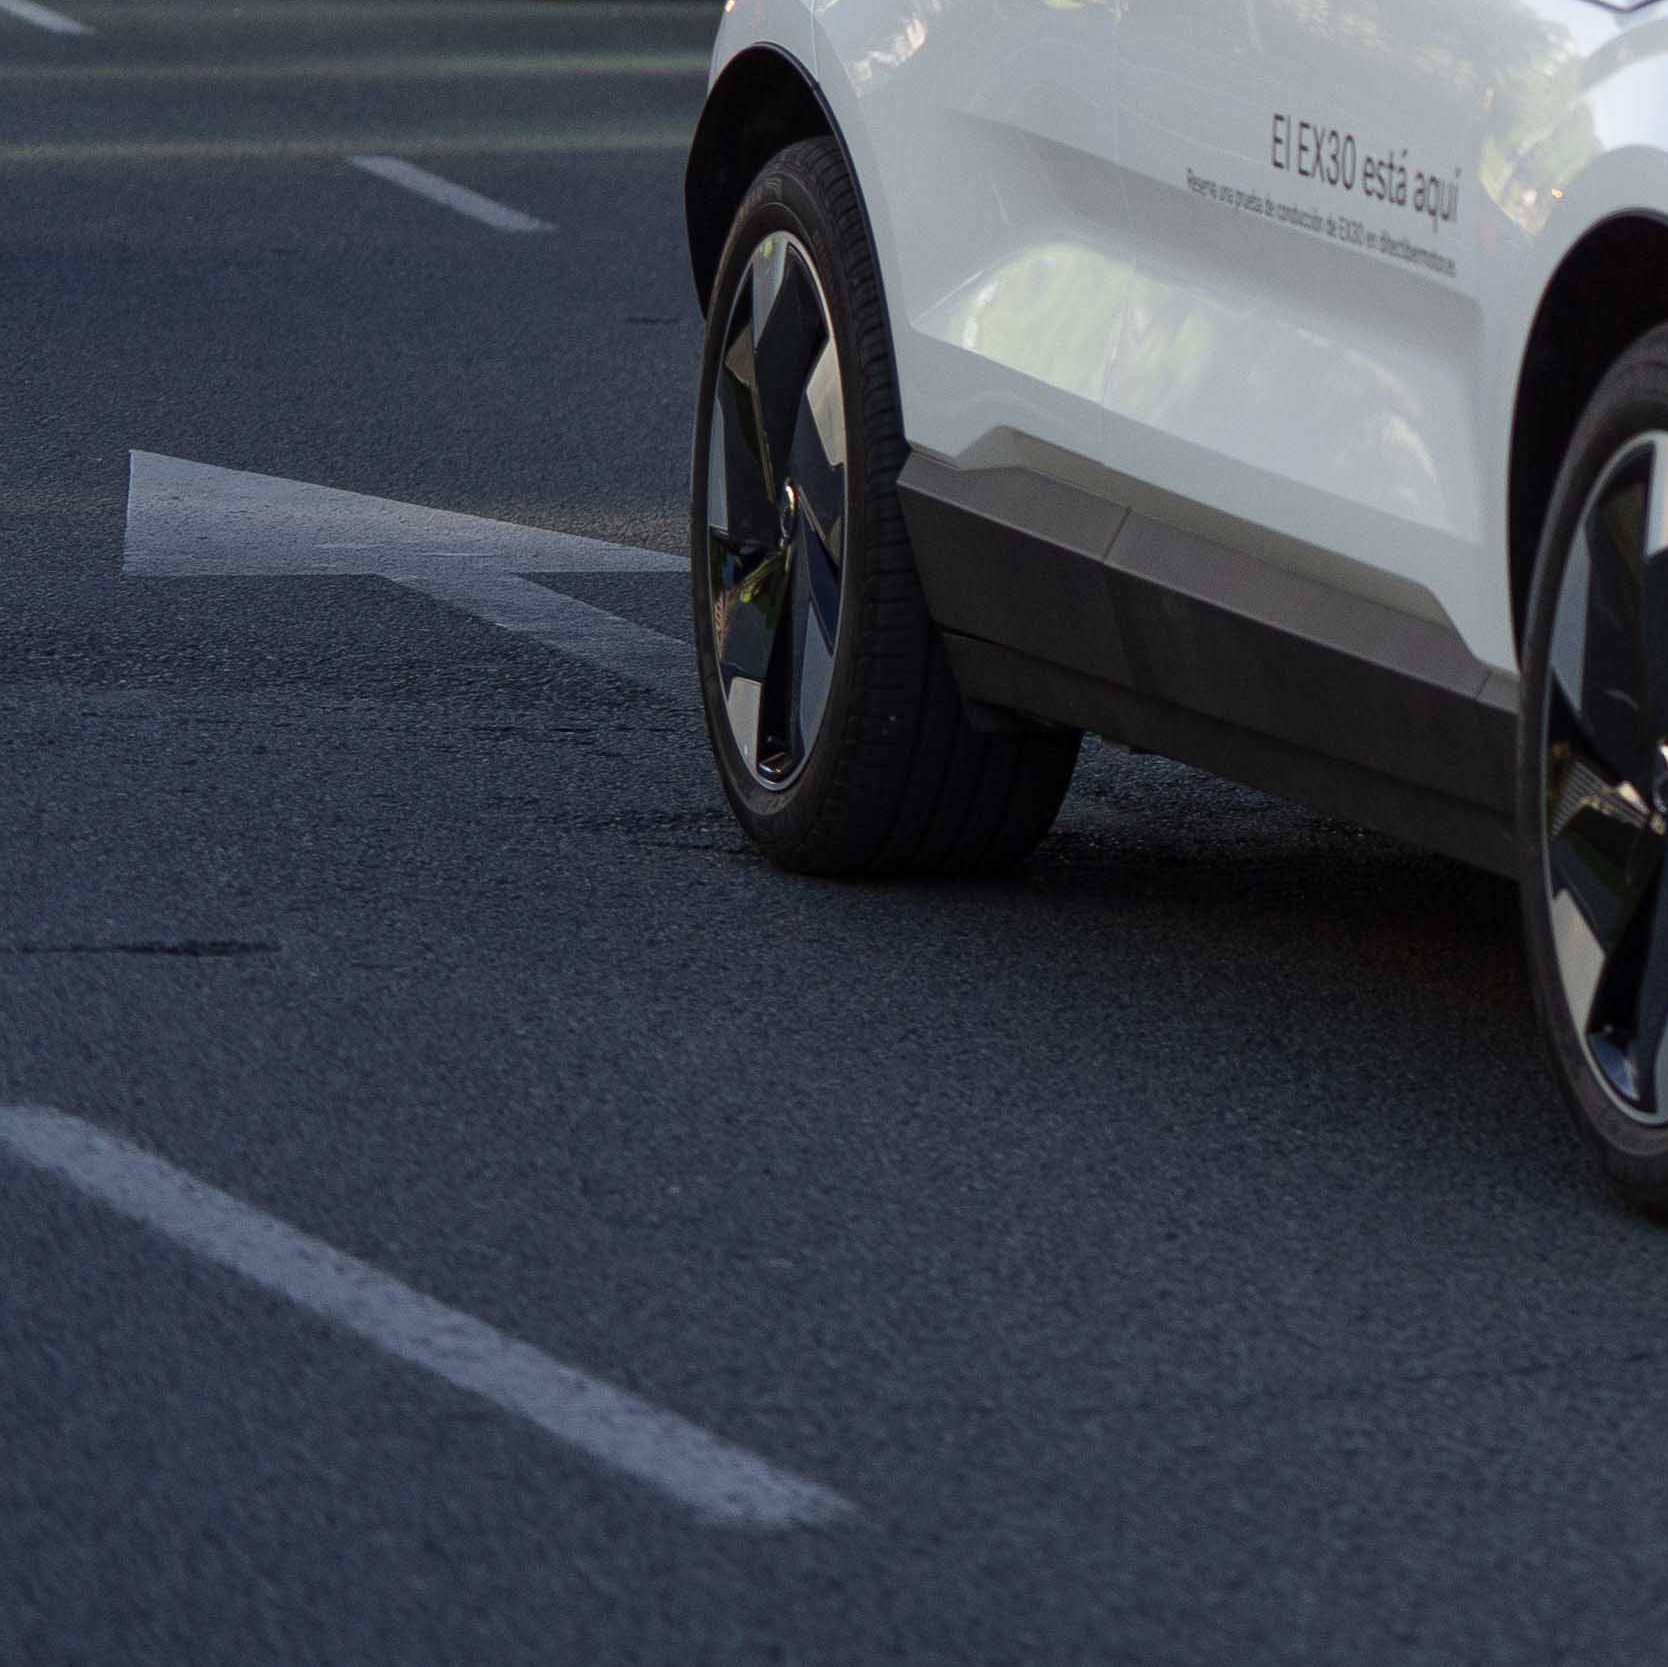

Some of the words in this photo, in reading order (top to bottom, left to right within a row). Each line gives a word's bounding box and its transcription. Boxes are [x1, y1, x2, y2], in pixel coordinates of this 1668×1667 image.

[1272, 113, 1292, 172] El
[1297, 121, 1357, 191] EX30
[1363, 147, 1408, 207] está
[1413, 166, 1462, 235] aquí
